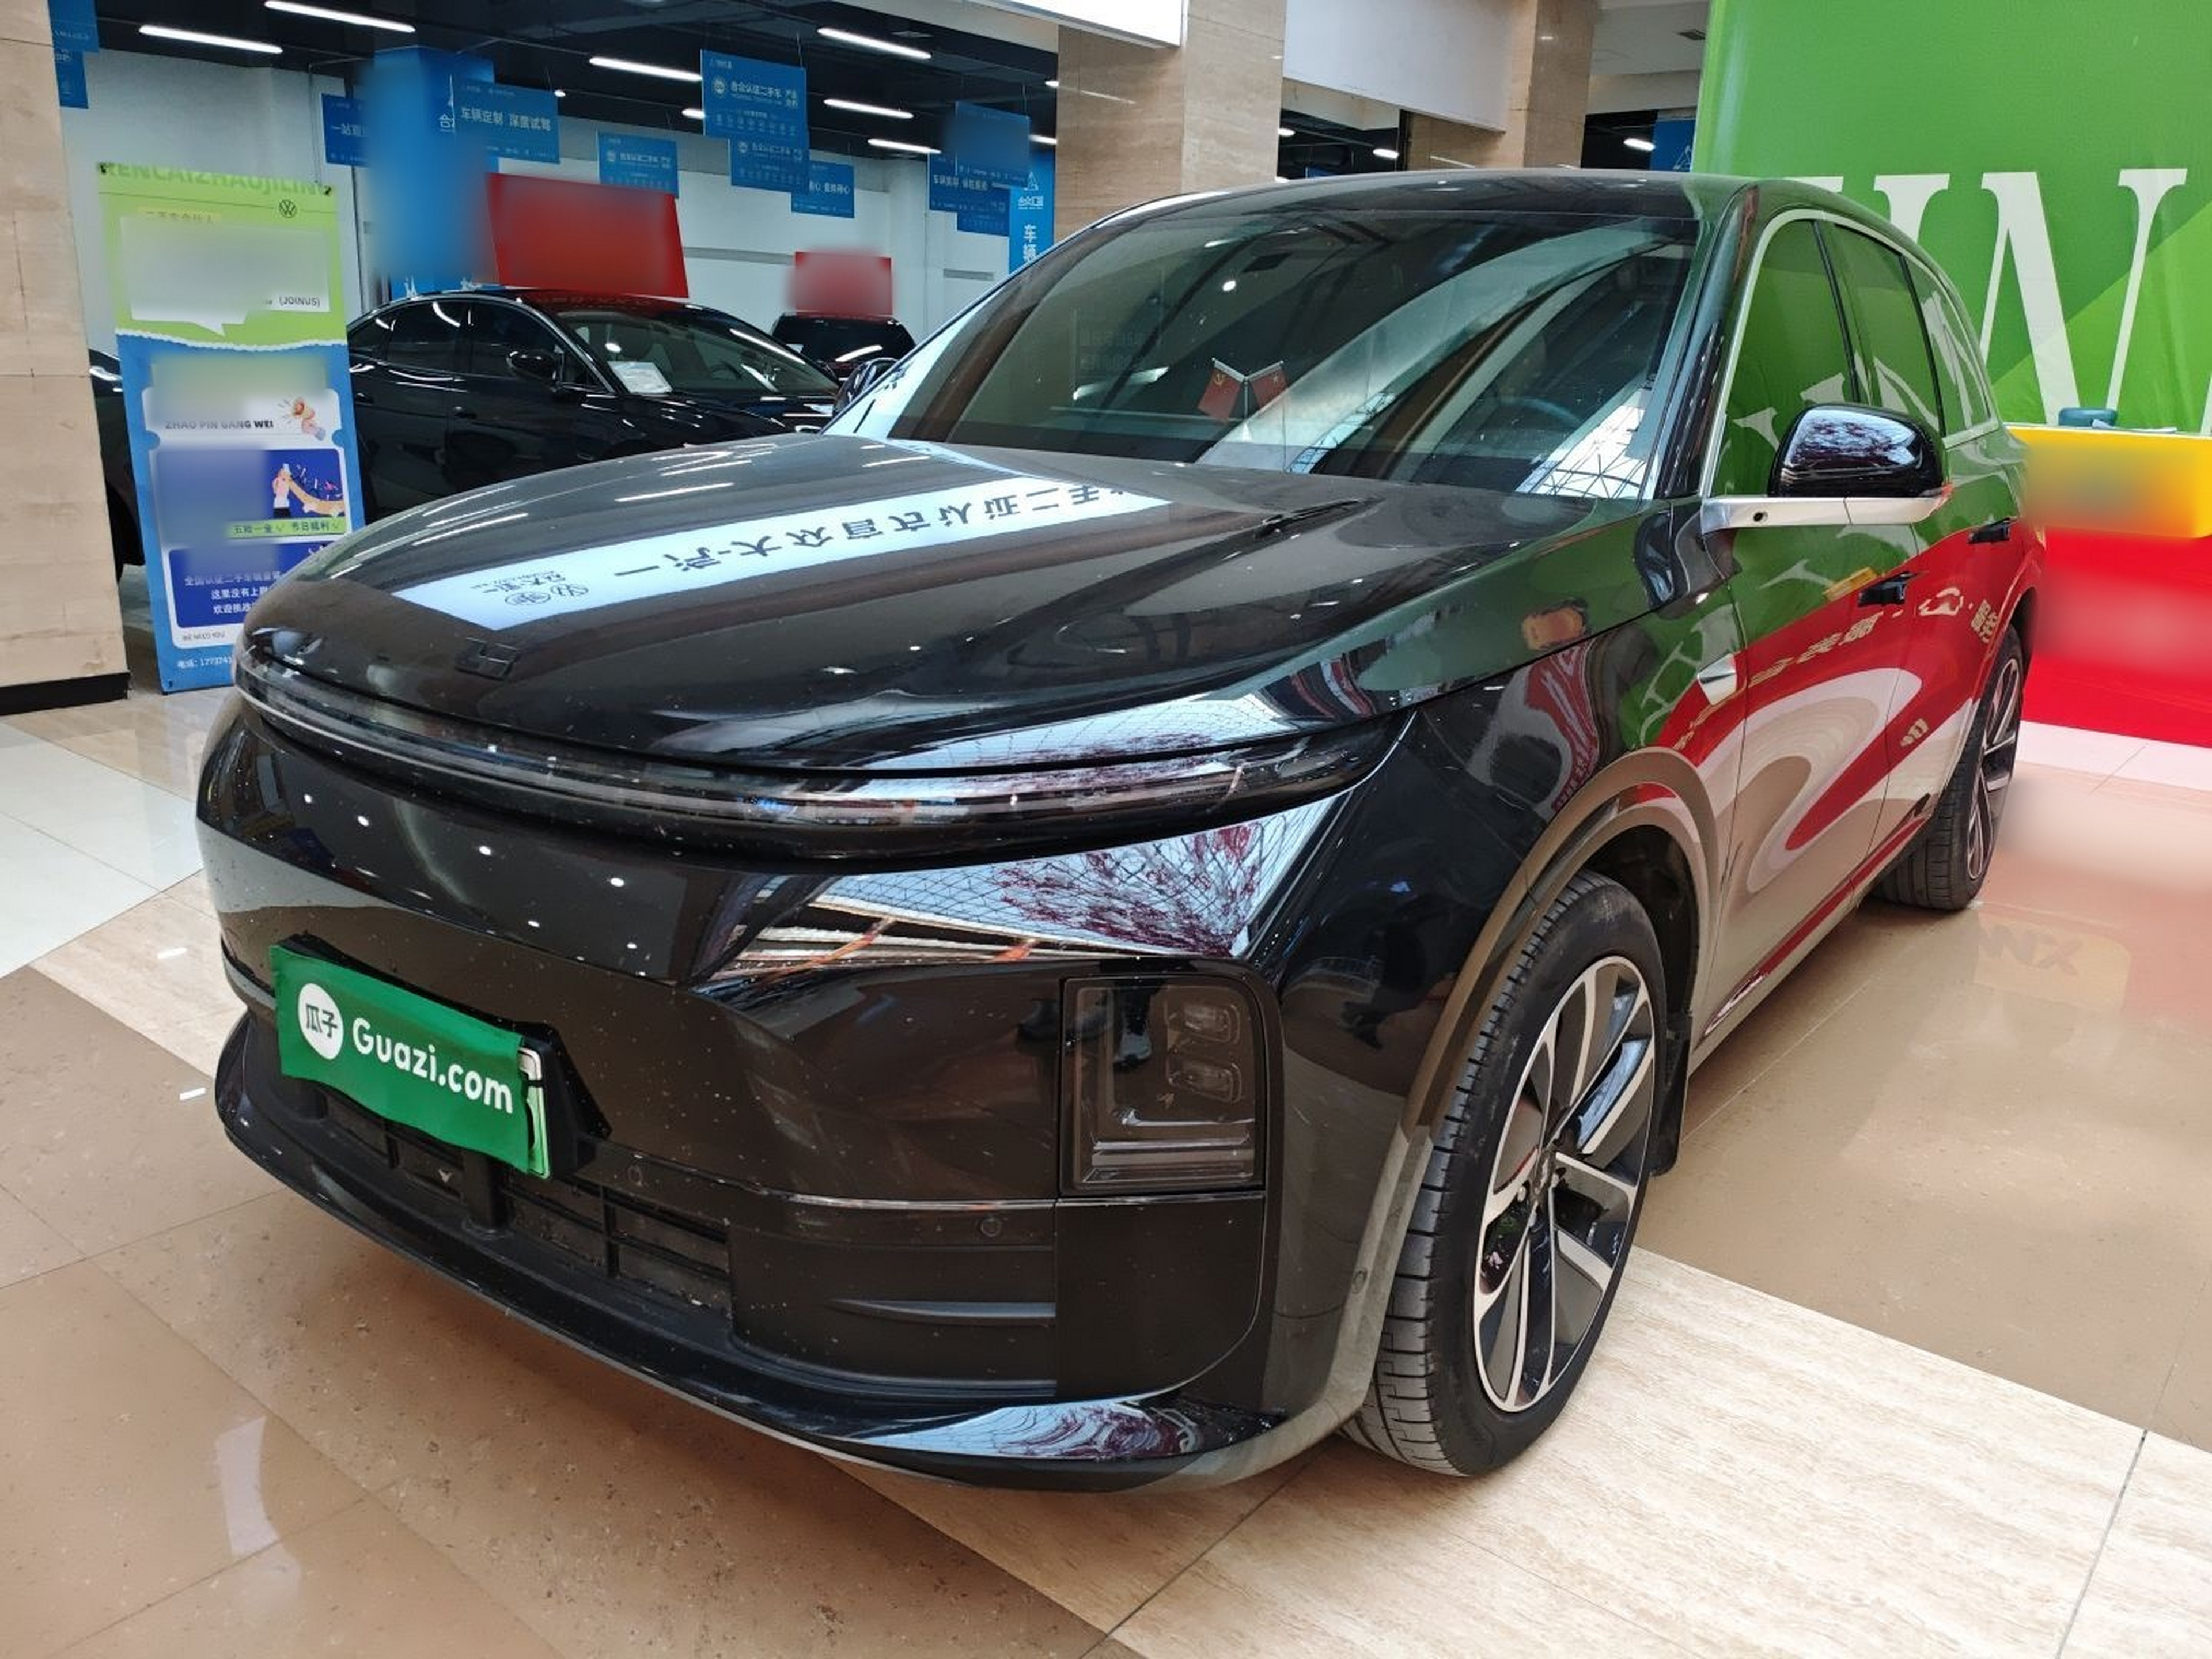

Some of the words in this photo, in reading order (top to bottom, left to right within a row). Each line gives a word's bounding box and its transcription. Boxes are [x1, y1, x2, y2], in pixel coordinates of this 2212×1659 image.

[460, 107, 503, 126] 车辆定制
[279, 296, 320, 307] (JOINUS)
[165, 420, 197, 430] ZHAO
[199, 421, 218, 429] PIN
[221, 420, 251, 429] GANG
[304, 1002, 339, 1039] 瓜子
[351, 1017, 513, 1115] Guazi.com
